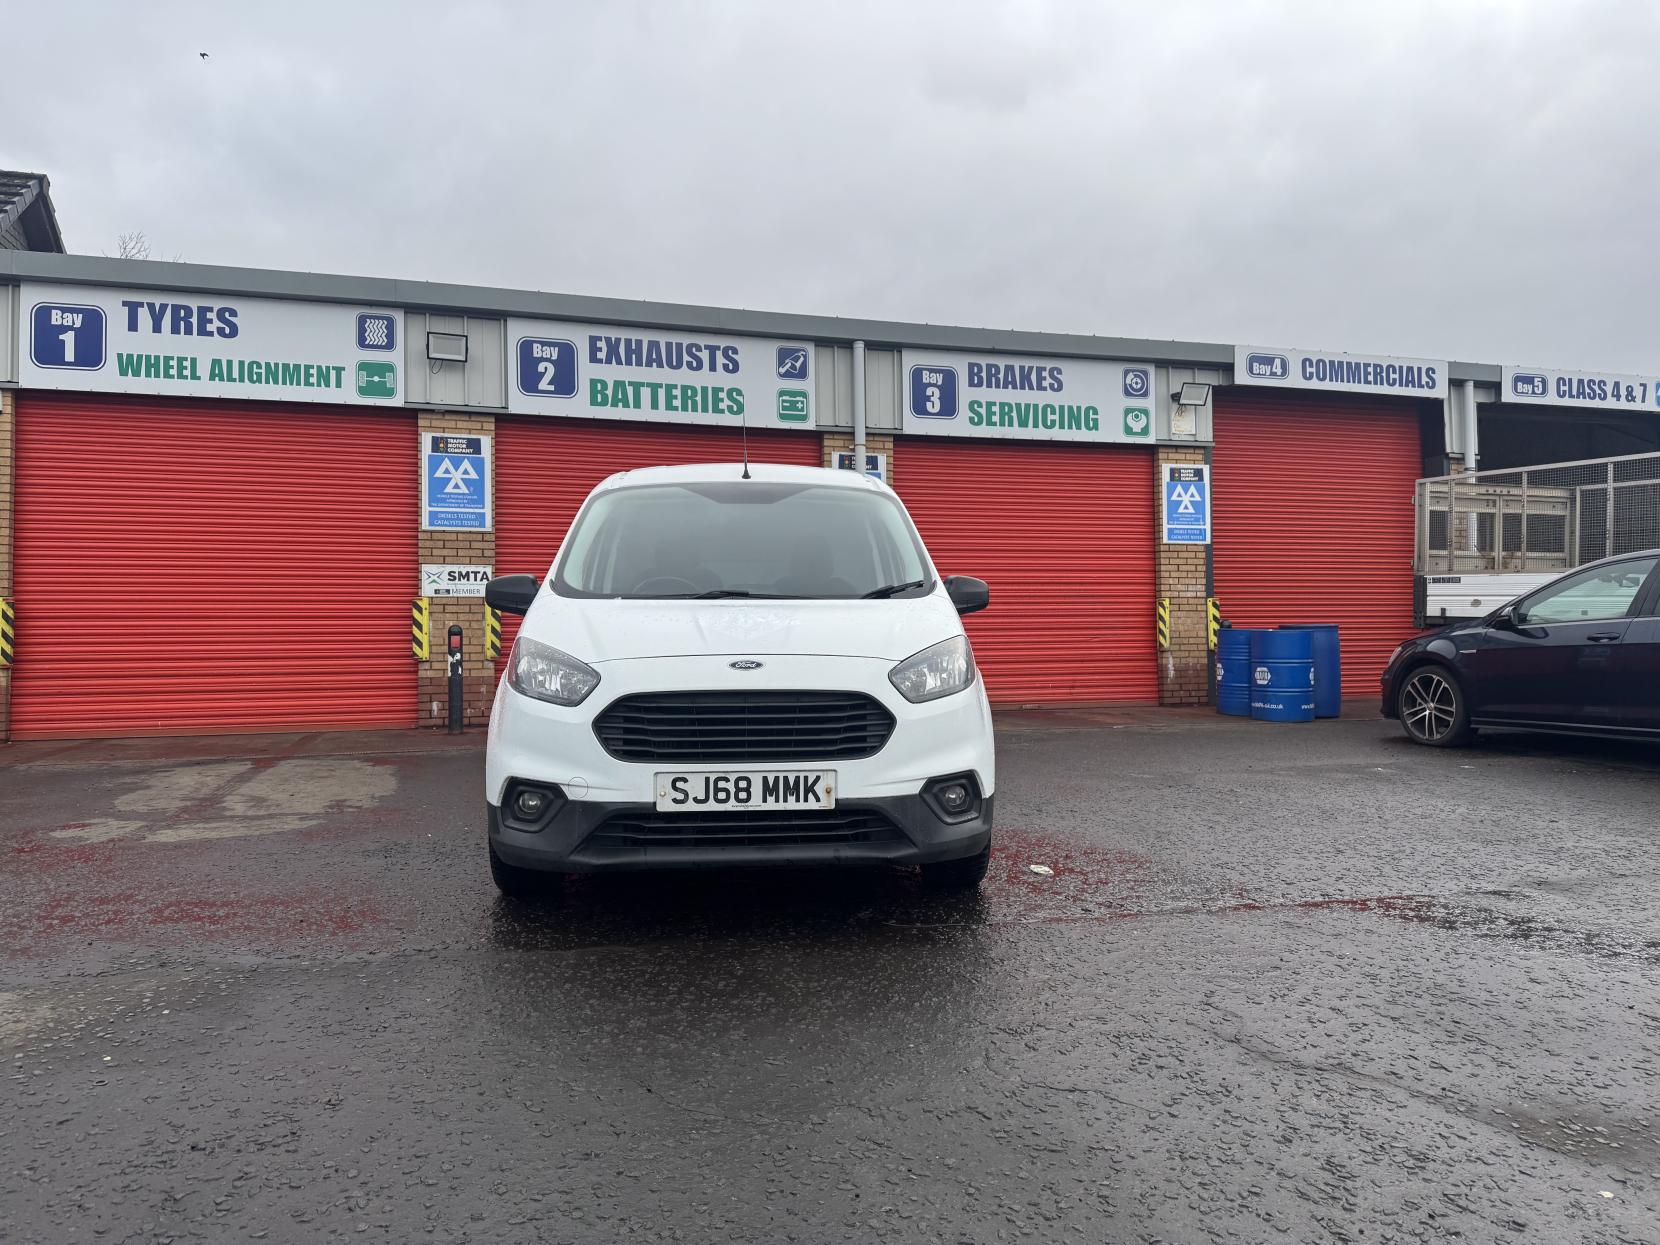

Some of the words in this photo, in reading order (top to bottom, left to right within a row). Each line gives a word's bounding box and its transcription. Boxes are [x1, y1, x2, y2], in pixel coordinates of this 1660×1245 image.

[51, 309, 83, 327] Bay
[121, 300, 239, 339] TYRES
[58, 330, 75, 363] 1
[533, 343, 558, 360] Bay
[588, 334, 740, 374] EXHAUSTS
[116, 352, 201, 381] WHEEL
[209, 358, 346, 389] ALIGNMENT
[537, 361, 555, 391] 2
[922, 370, 943, 386] Bay
[967, 362, 1064, 393] BRAKES
[1252, 362, 1271, 376] Bay
[1272, 358, 1283, 376] 4
[1301, 357, 1437, 390] COMMERCIALS
[589, 378, 745, 416] BATTERIES
[925, 386, 941, 414] 3
[1517, 382, 1532, 394] Bay
[1533, 377, 1543, 394] 5
[1556, 376, 1608, 401] CLASS
[1611, 381, 1622, 402] 4
[1625, 385, 1636, 403] &
[1639, 383, 1648, 403] 7
[968, 400, 1099, 432] SERVICING
[447, 570, 490, 582] SMTA
[671, 775, 752, 805] SJ68
[761, 775, 822, 804] MMK
